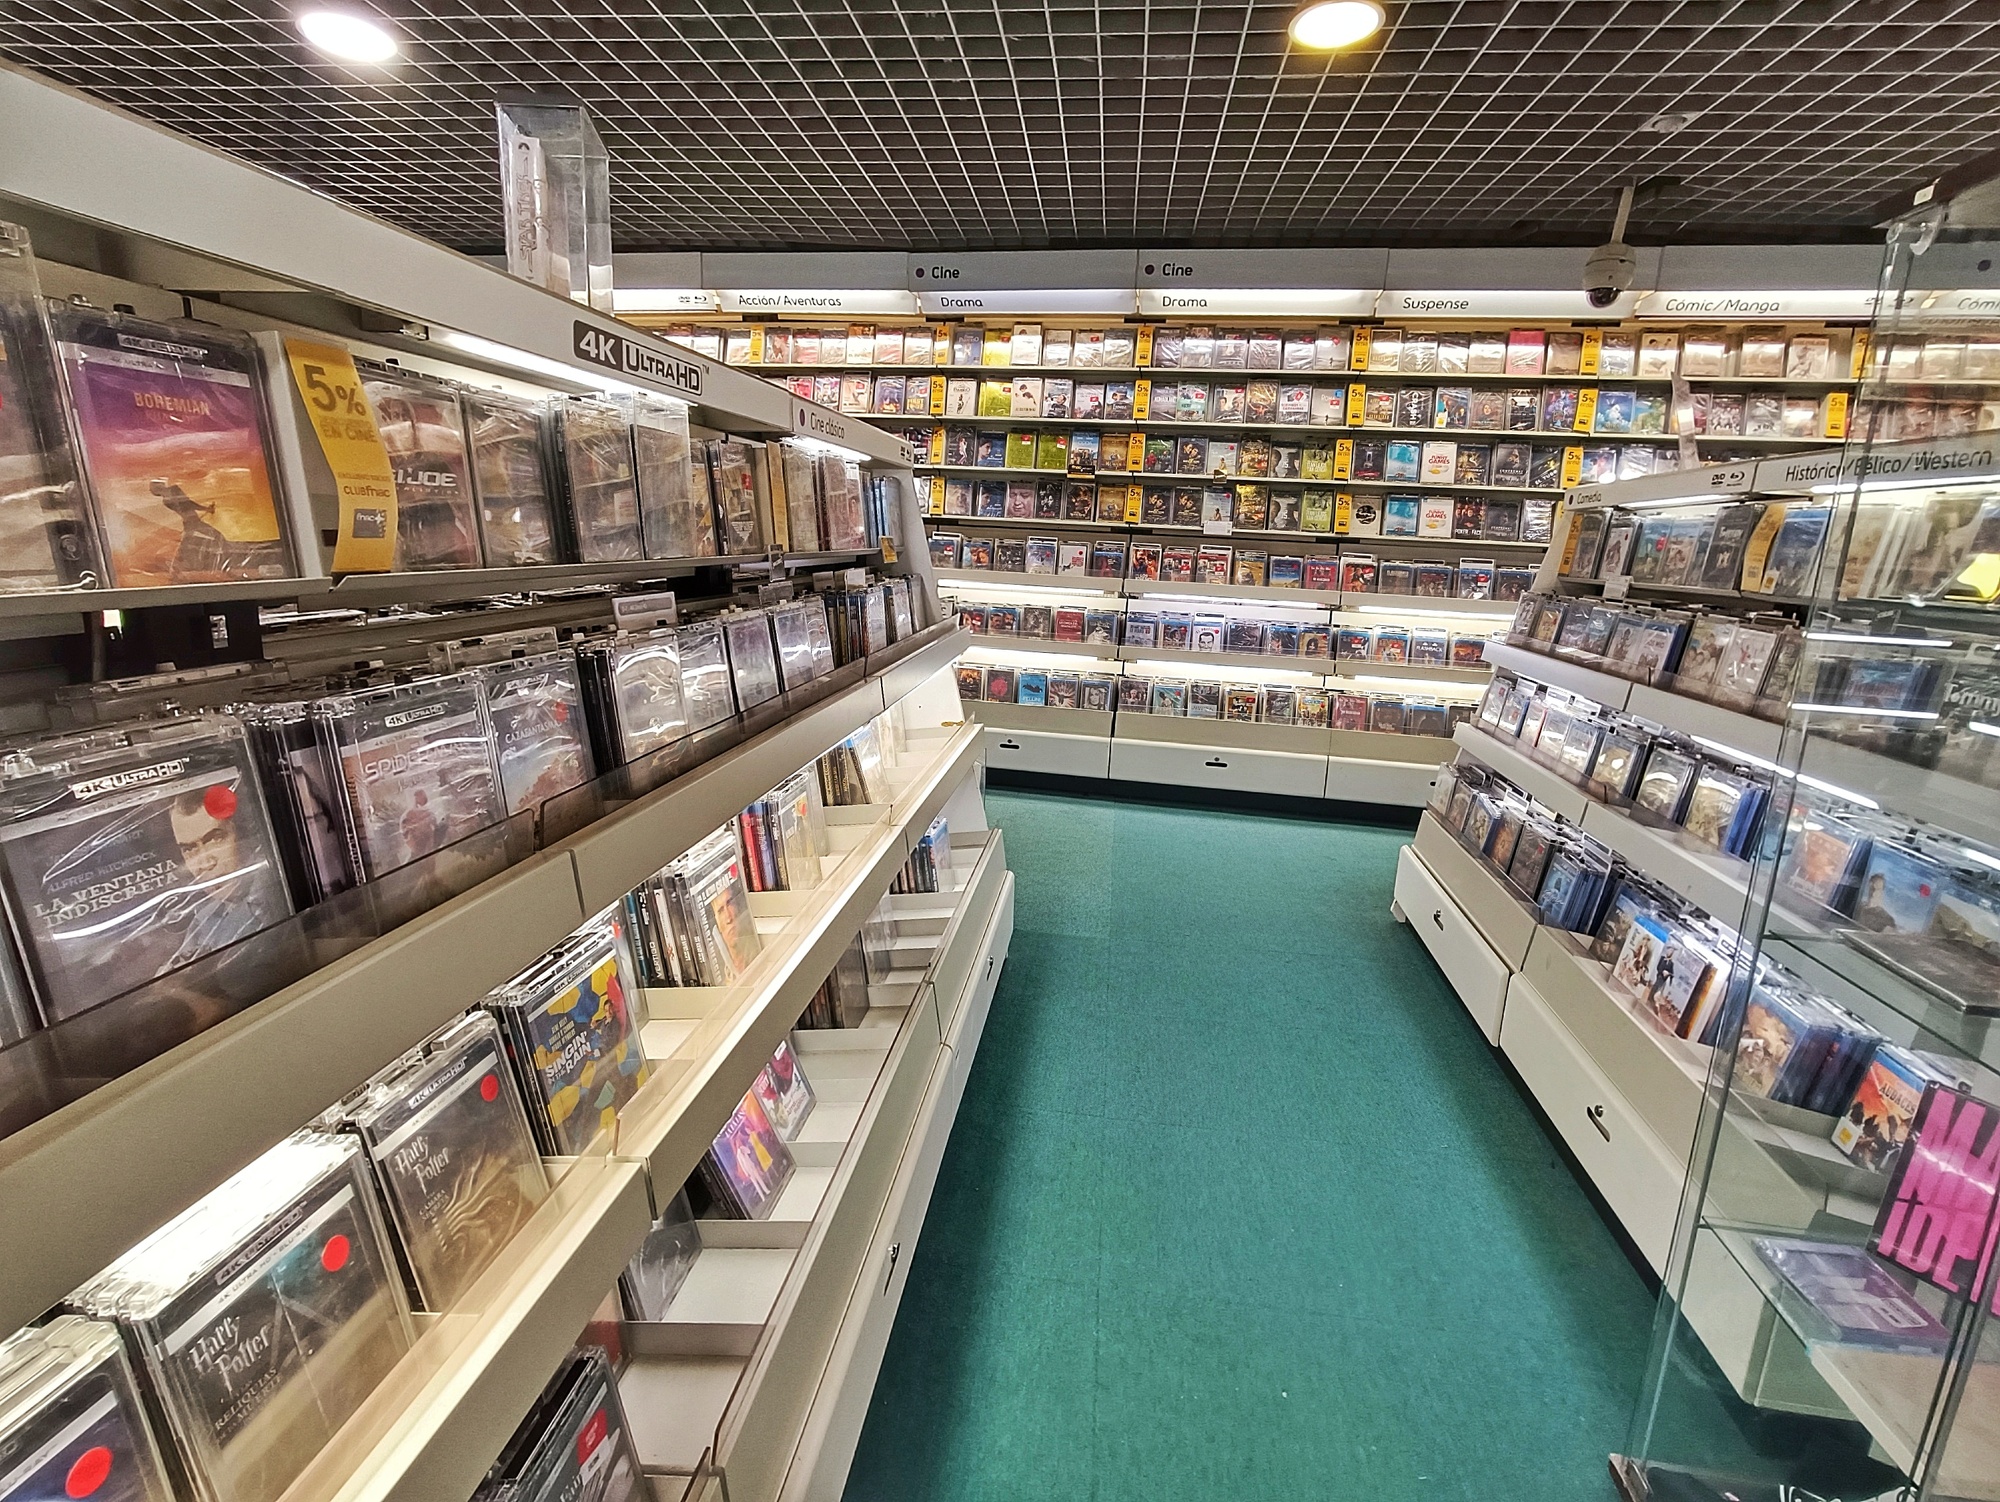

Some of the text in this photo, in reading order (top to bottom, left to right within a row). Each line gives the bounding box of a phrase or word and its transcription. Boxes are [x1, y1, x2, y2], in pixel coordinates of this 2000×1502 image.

[931, 266, 960, 279] Cine
[1162, 263, 1193, 277] Cine
[940, 297, 983, 307] Drama
[1162, 296, 1208, 307] Drama
[1402, 297, 1469, 311] Suspense
[1666, 299, 1780, 314] Cómic/Manga
[580, 331, 616, 365] 4K
[134, 392, 210, 417] BOHEMIAN
[304, 364, 367, 417] 5%
[810, 411, 845, 440] Cine clásico
[1577, 490, 1602, 504] Comedia
[75, 781, 108, 797] 4K
[34, 859, 179, 918] LA VENTANA
[43, 872, 179, 929] INDISCRETA
[649, 941, 663, 978] VERTIGO
[545, 1031, 588, 1079] SINGIN'
[566, 1042, 592, 1073] RAIN
[1879, 1083, 1916, 1116] AUDACES
[395, 1135, 429, 1178] Harry
[413, 1146, 451, 1198] Potter
[231, 1267, 259, 1294] ULTRA
[278, 1223, 311, 1254] BLU-RAY
[188, 1315, 242, 1376] Harry
[214, 1322, 273, 1400] Potter
[213, 1366, 279, 1431] RELIQUIAS
